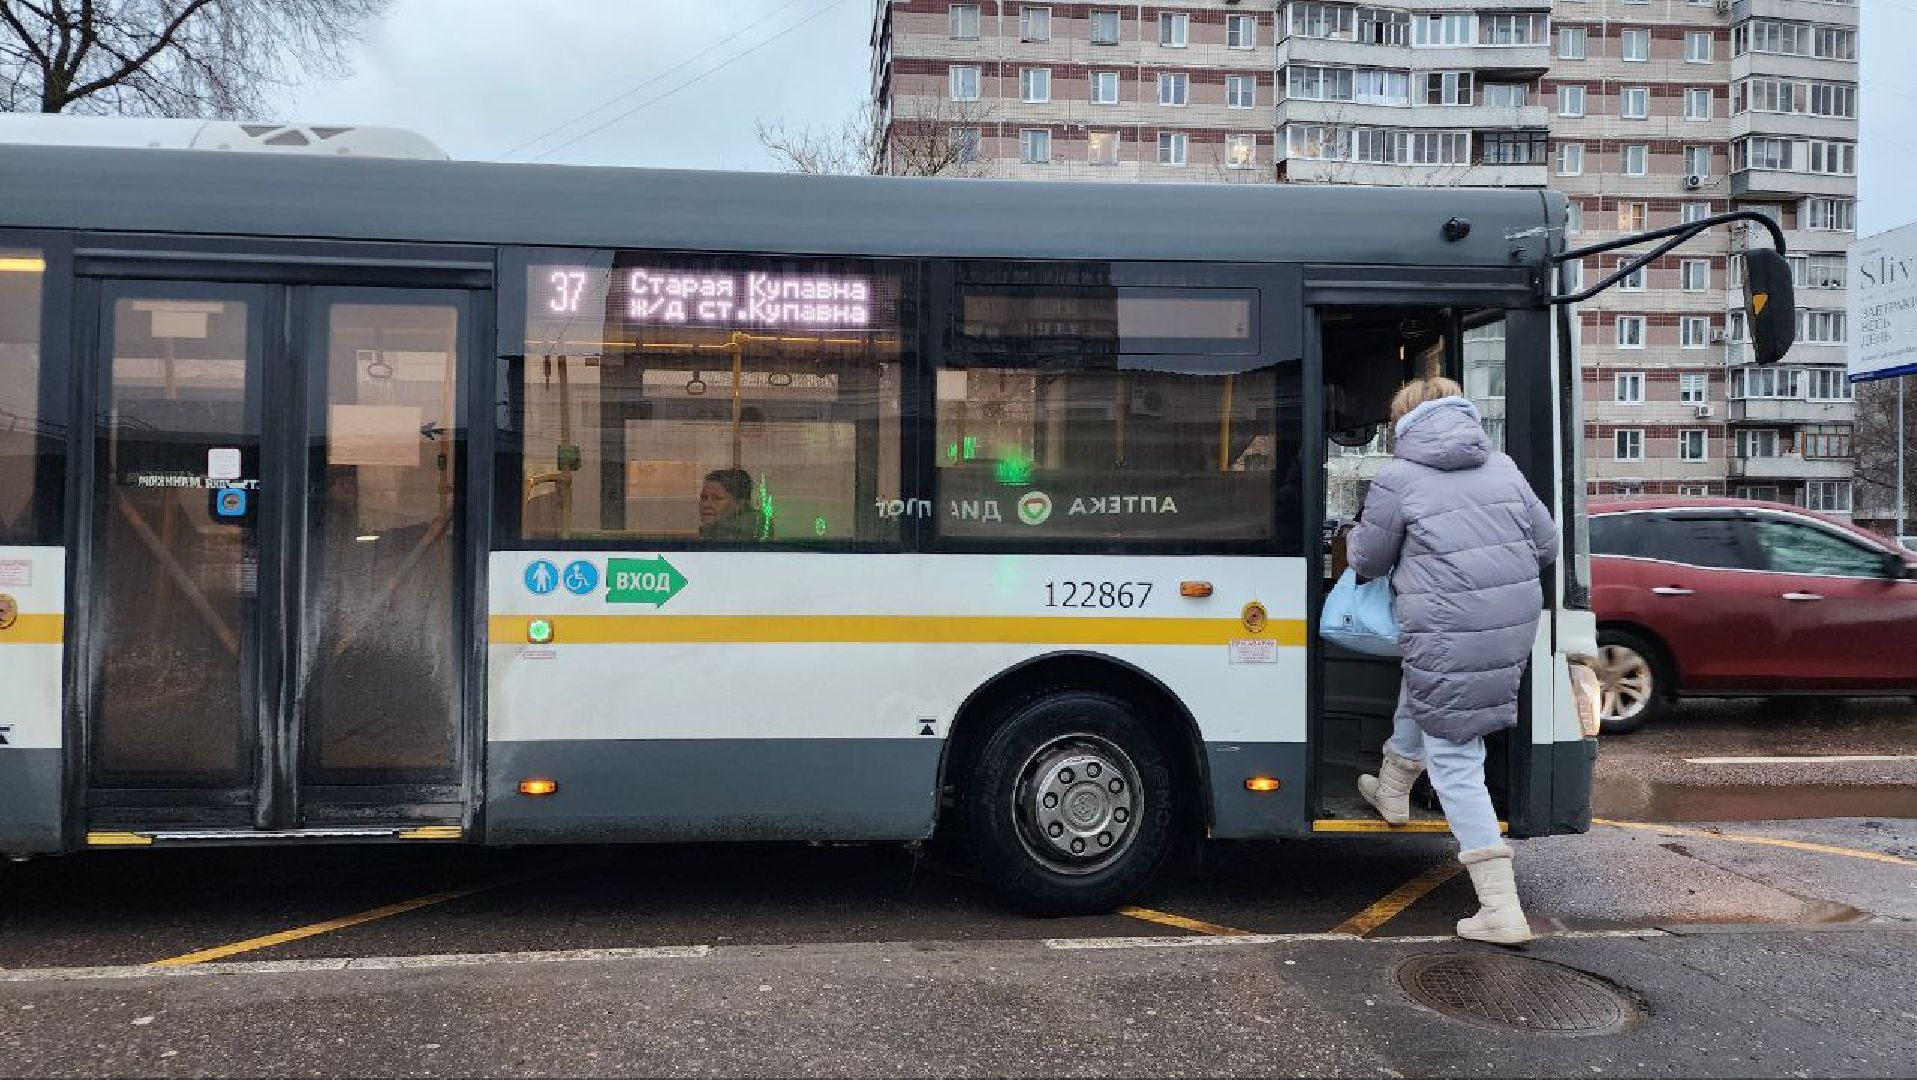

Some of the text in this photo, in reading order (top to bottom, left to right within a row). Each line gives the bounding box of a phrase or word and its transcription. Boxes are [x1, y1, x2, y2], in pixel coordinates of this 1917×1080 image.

[549, 271, 586, 311] 37
[631, 271, 868, 300] Старая Купавна
[616, 572, 671, 594] ВХОД
[1044, 581, 1153, 608] 122867
